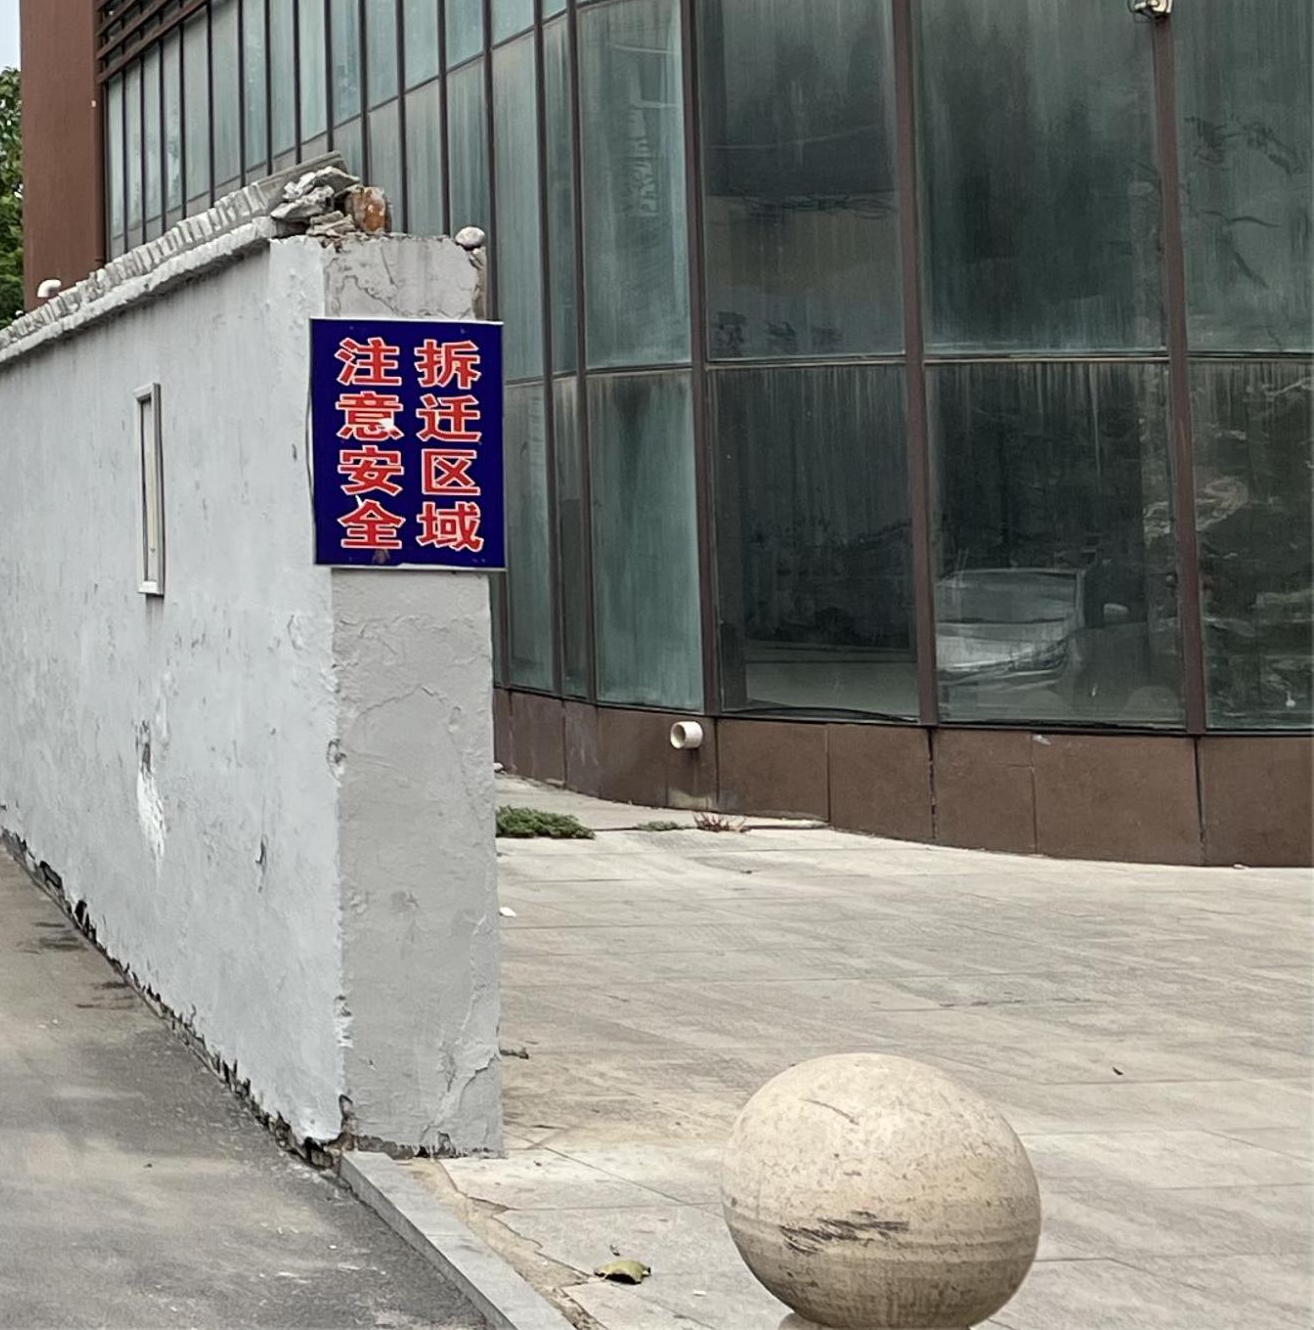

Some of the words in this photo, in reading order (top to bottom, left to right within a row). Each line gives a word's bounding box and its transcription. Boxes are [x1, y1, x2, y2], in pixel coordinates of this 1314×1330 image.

[334, 336, 406, 550] 注意安全
[414, 338, 484, 552] 拆迁区域
